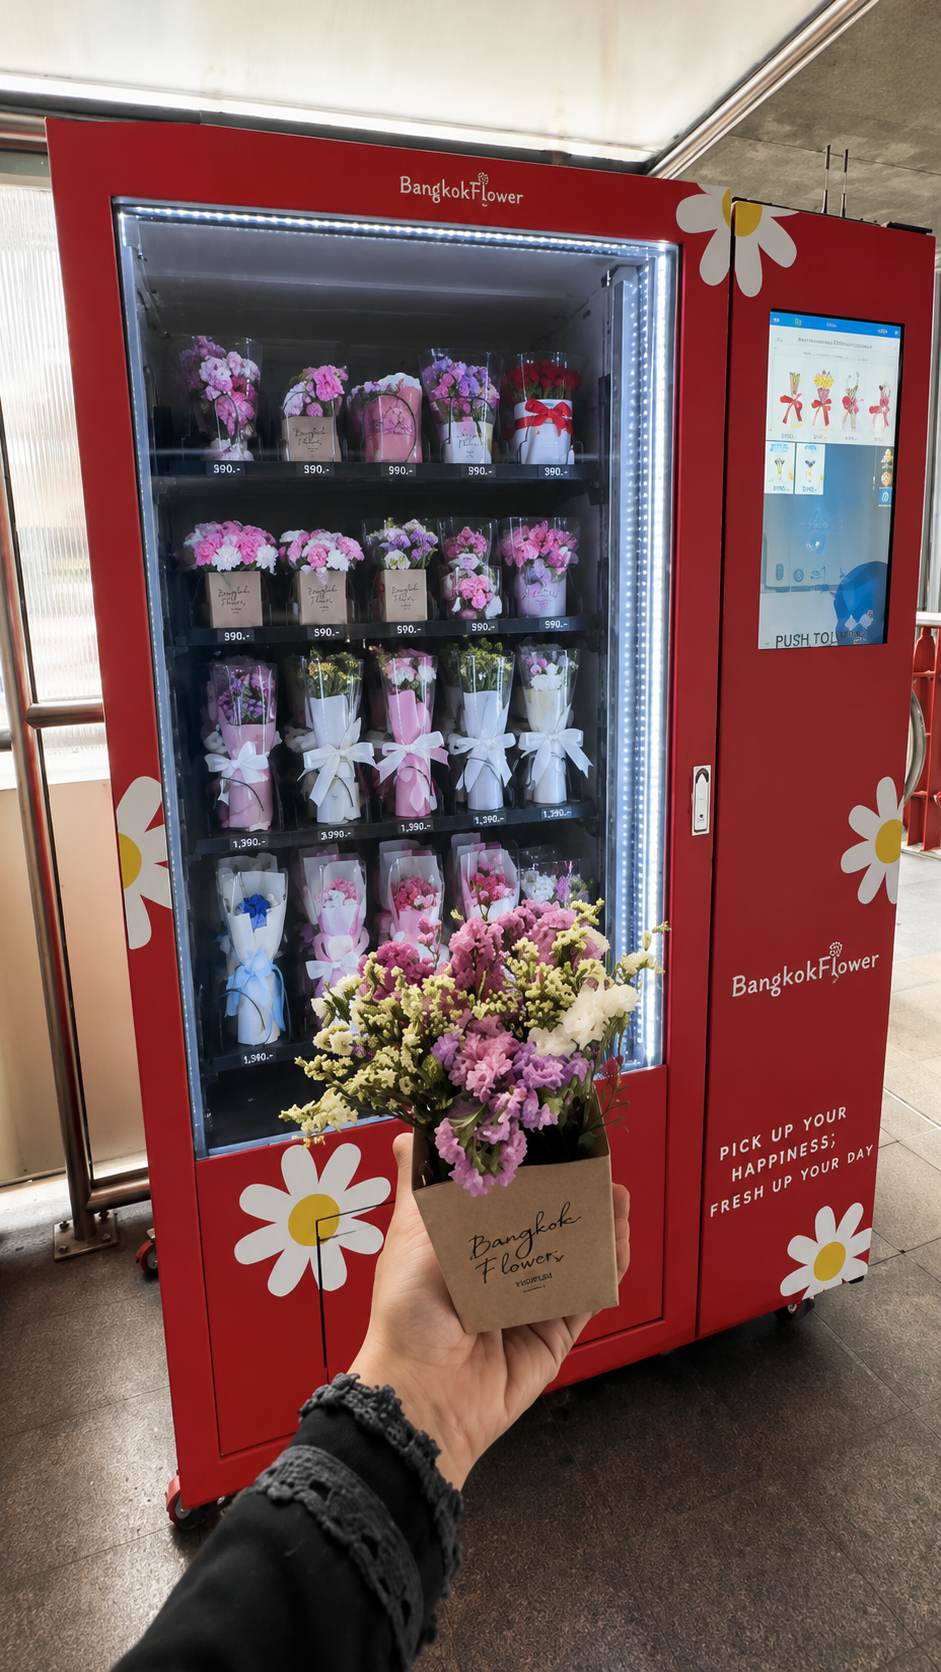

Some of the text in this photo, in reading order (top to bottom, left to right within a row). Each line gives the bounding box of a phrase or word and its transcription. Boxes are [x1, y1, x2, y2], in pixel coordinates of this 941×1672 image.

[400, 171, 524, 207] BangkokFlower
[776, 633, 809, 649] PUSH
[732, 942, 879, 997] BangkokFlower
[720, 1106, 847, 1161] PICK UP YOUR
[710, 1145, 873, 1217] FRESH UP YOUR DAY
[468, 1201, 582, 1260] Bangkok
